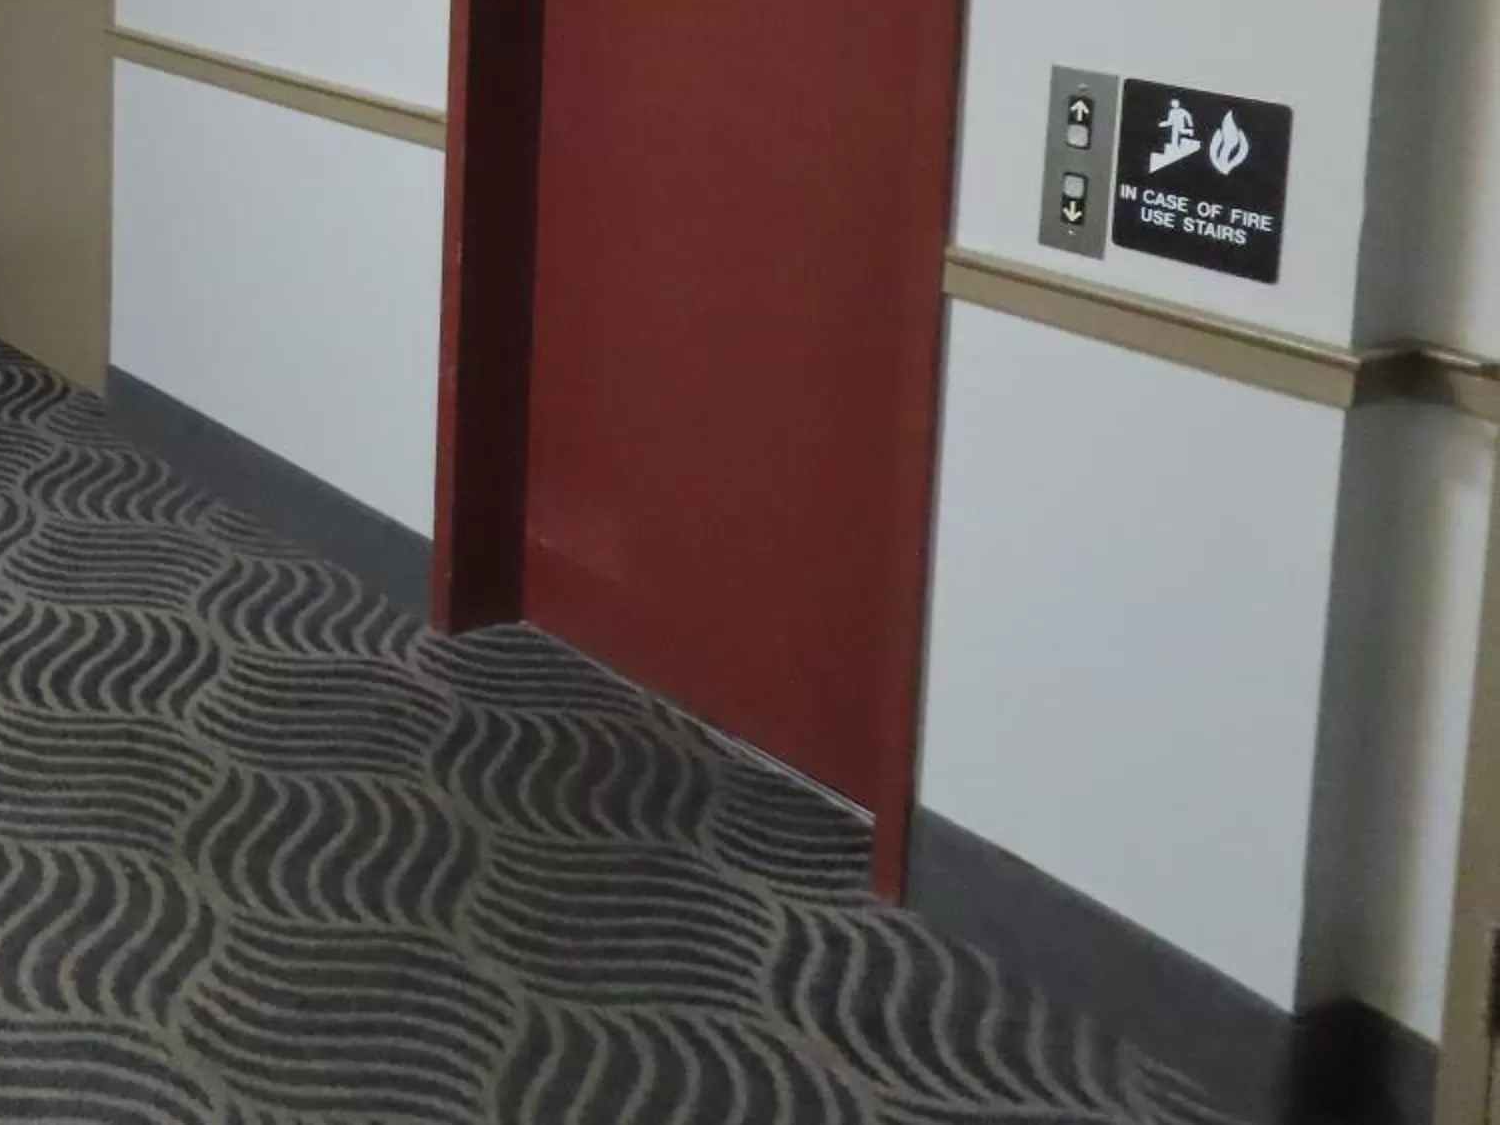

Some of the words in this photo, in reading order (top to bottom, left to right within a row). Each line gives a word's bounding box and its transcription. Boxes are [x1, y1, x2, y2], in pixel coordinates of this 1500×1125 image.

[1120, 183, 1137, 201] IN
[1143, 189, 1189, 213] CASE
[1197, 201, 1223, 219] OF
[1230, 208, 1274, 232] FIRE
[1140, 207, 1175, 228] USE
[1183, 216, 1248, 245] STAIRS
